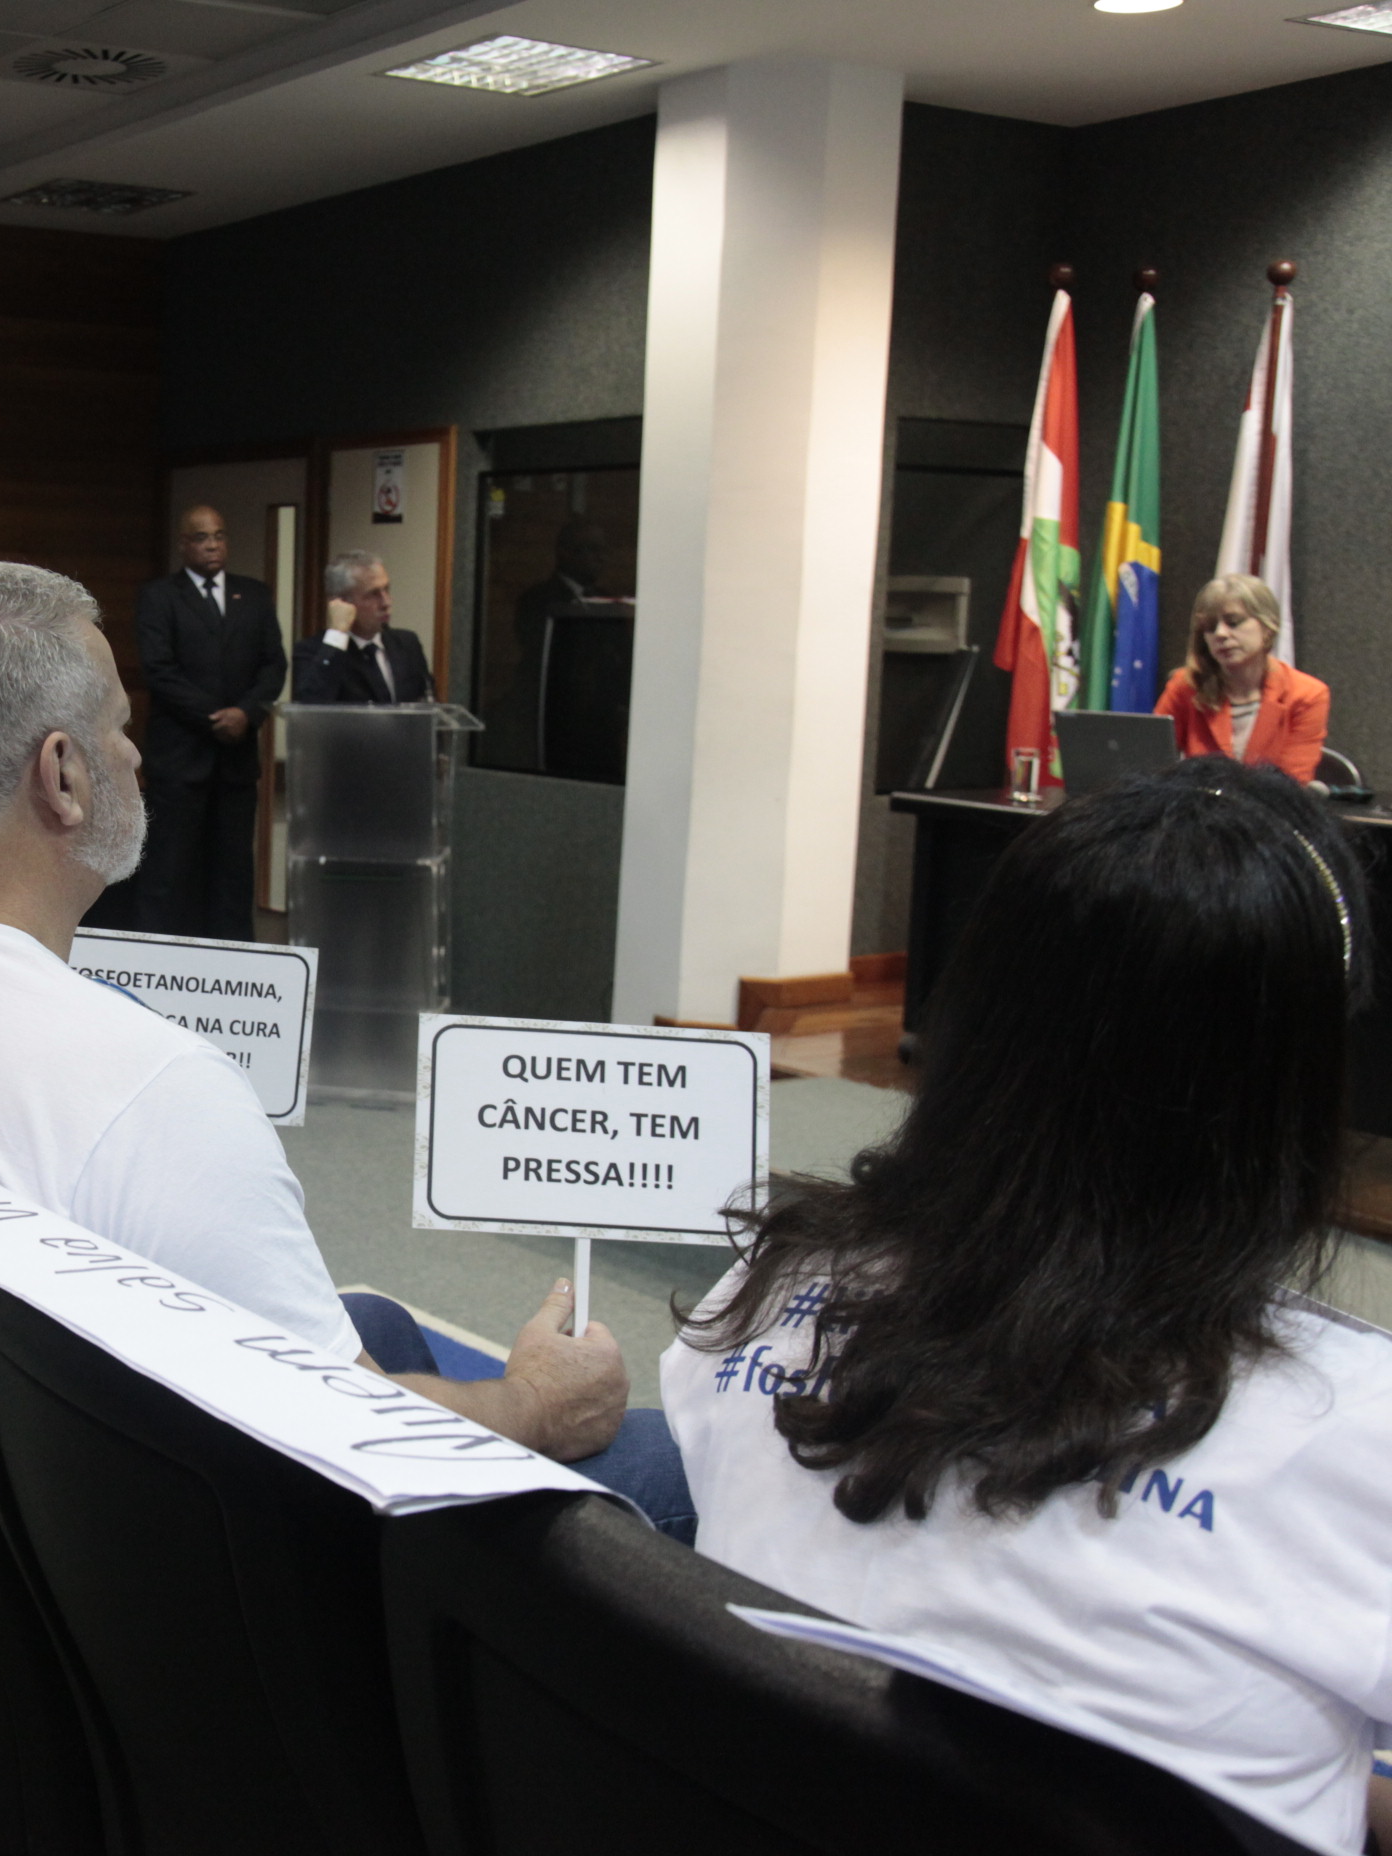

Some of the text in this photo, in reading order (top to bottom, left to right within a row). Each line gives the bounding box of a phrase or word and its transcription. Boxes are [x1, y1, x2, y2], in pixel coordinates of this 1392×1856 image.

[70, 966, 283, 1003] SFOETANOLAMINA,
[195, 1016, 224, 1035] NA
[228, 1019, 281, 1039] CURA
[501, 1053, 687, 1089] QUEM TEM
[477, 1097, 700, 1141] CÂNCER, TEM
[502, 1155, 674, 1191] PRESSA!!!!
